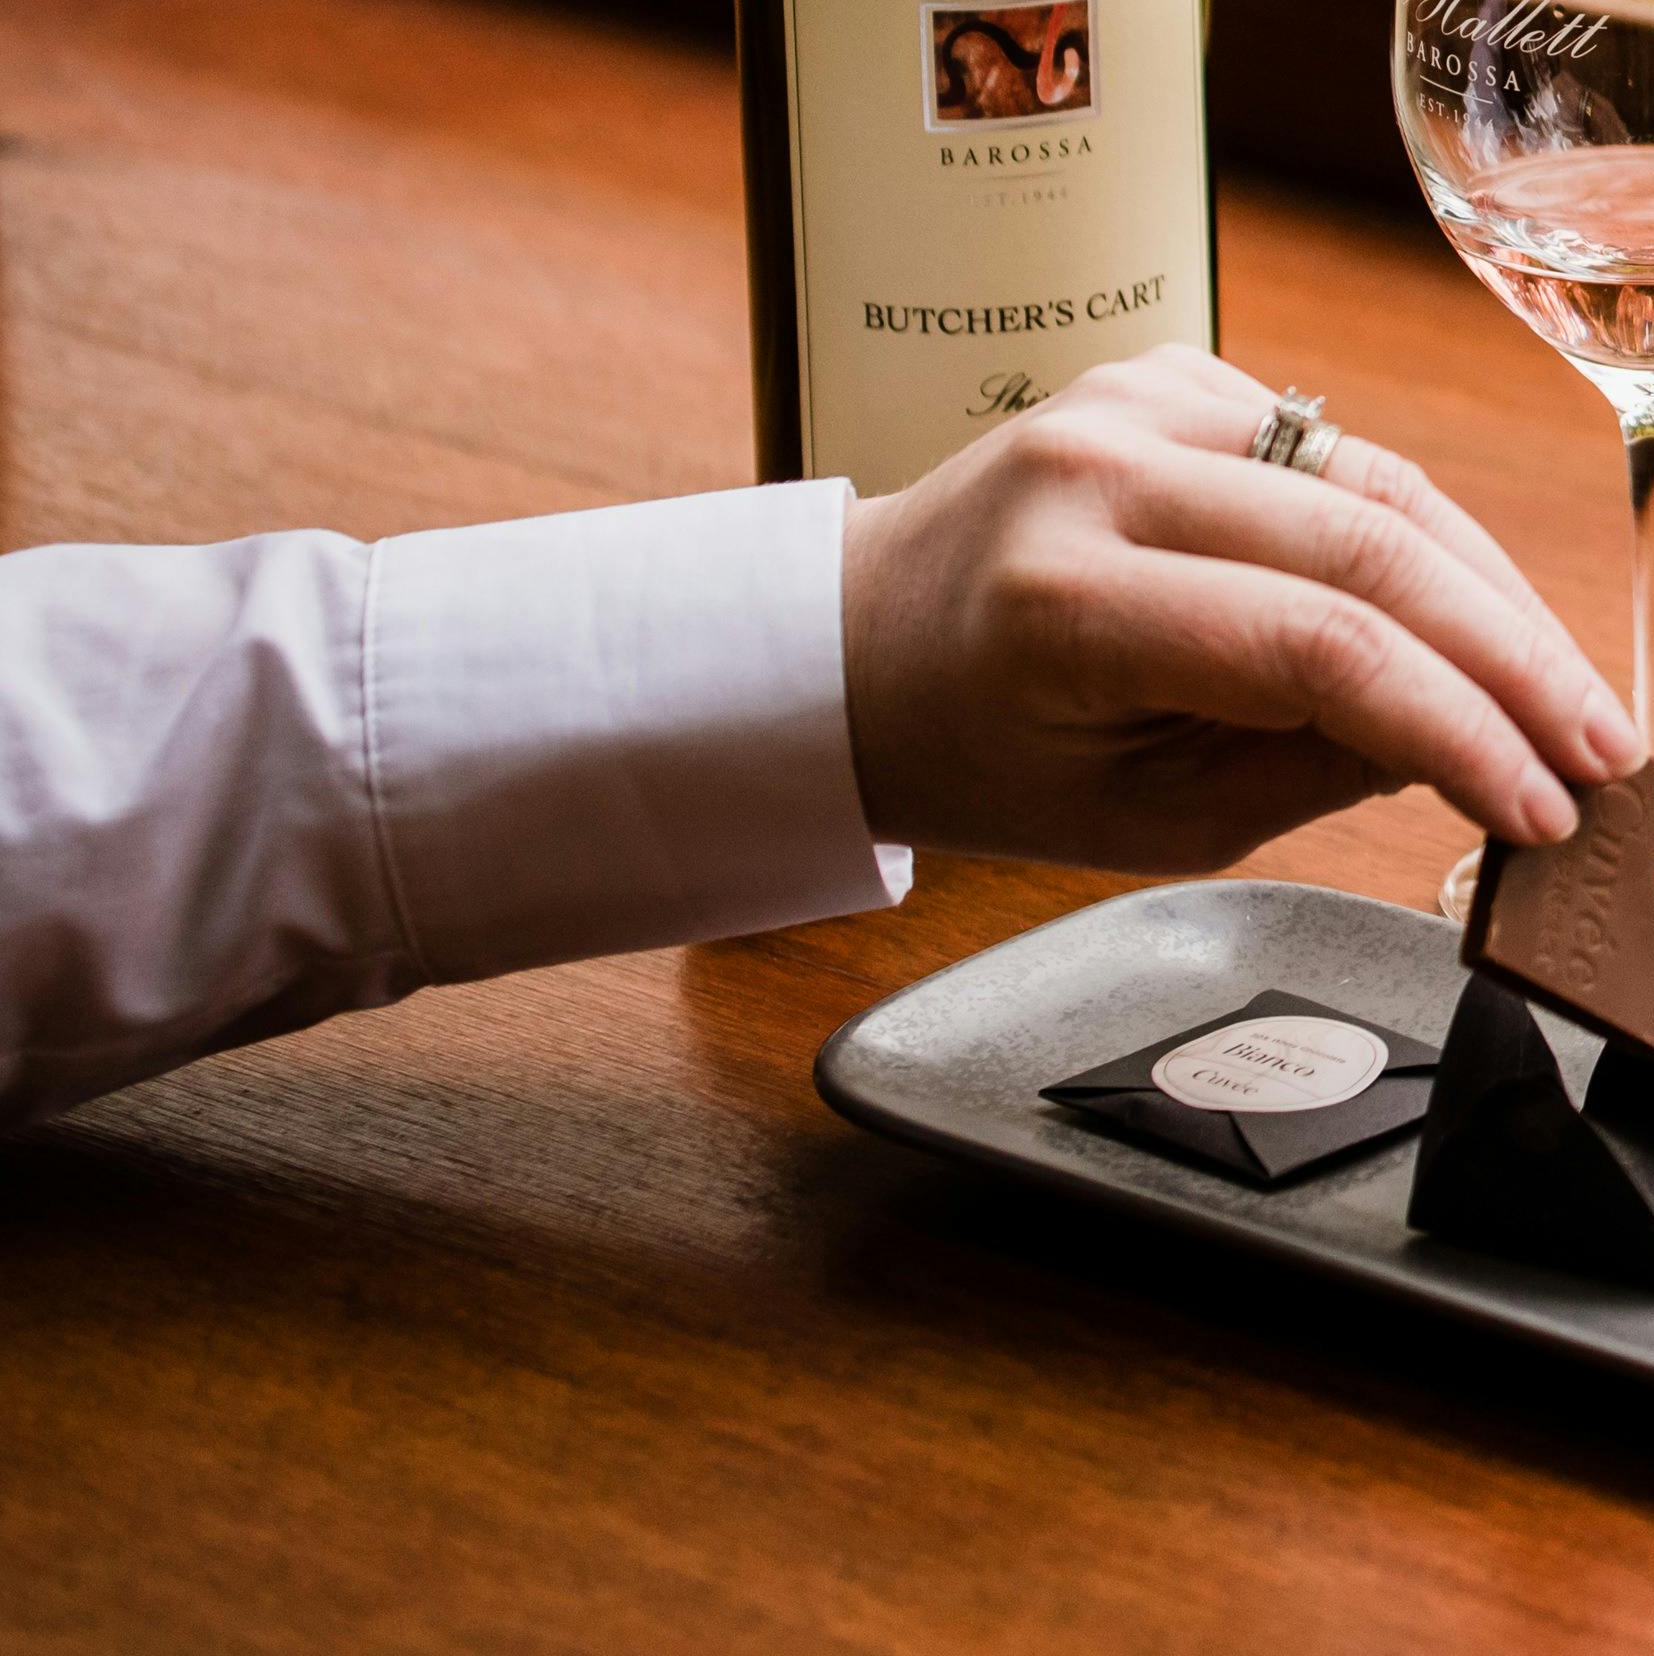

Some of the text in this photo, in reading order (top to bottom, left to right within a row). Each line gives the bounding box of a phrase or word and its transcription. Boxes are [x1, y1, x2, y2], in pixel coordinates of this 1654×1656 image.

[1406, 30, 1521, 92] BAROSSA
[940, 136, 1095, 168] BAROSSA
[862, 273, 1167, 336] BUTCHER'S CART
[1222, 1042, 1316, 1079] Bianco
[1192, 1069, 1260, 1097] Cuvée
